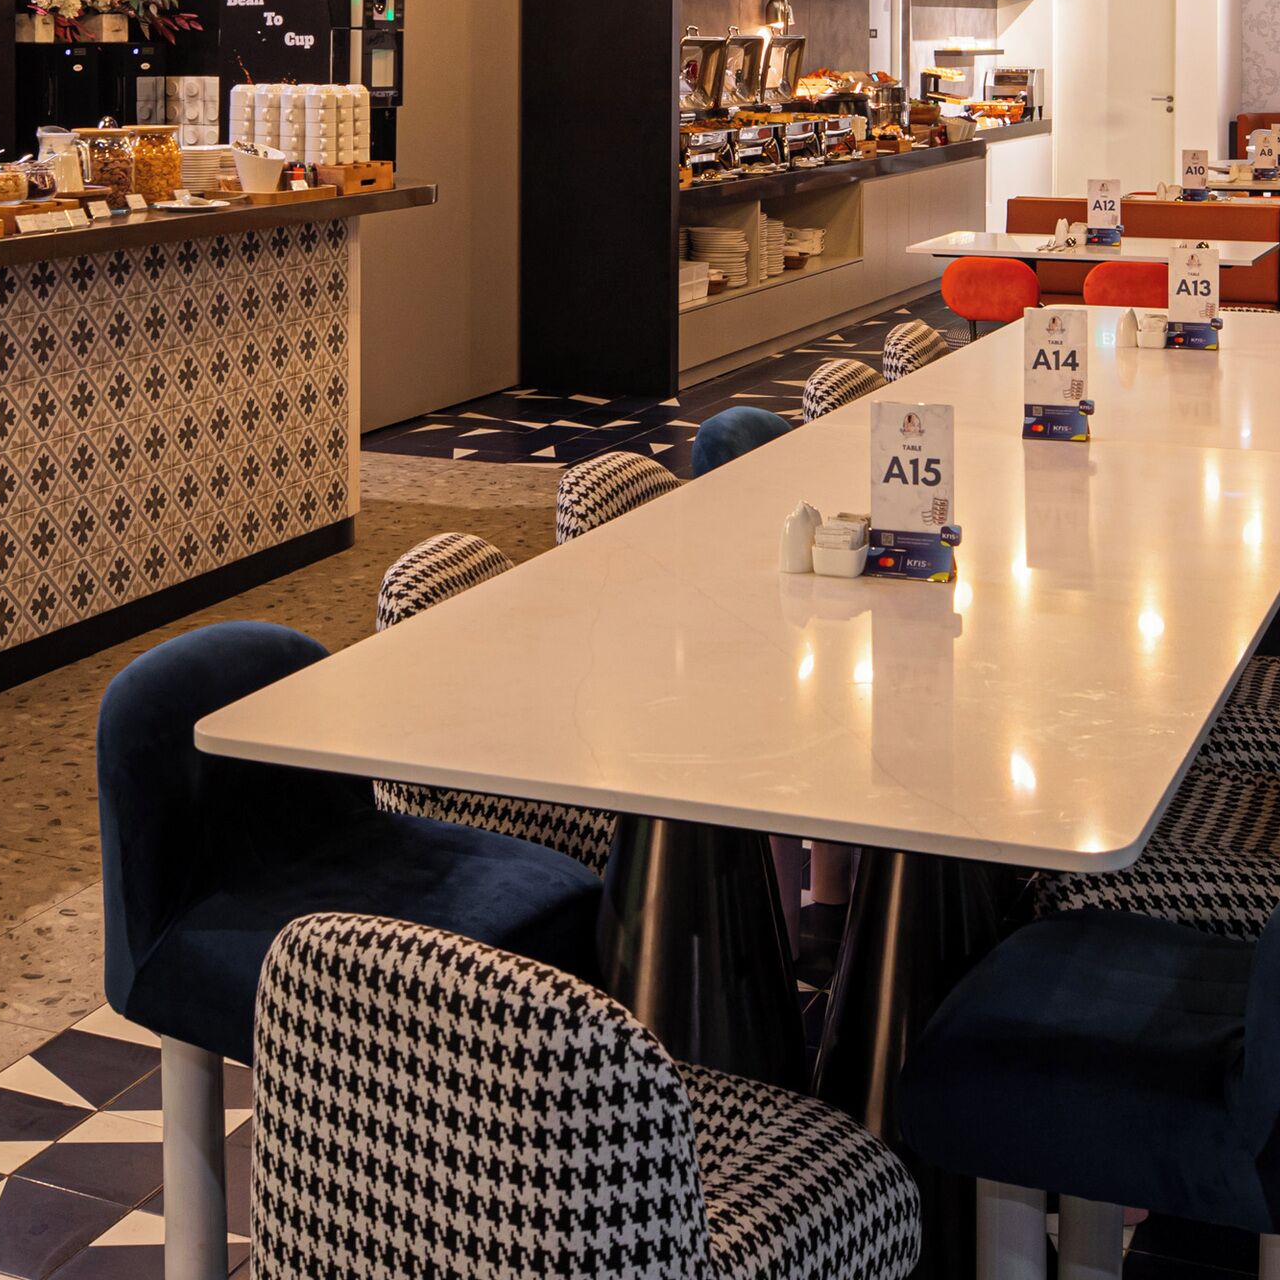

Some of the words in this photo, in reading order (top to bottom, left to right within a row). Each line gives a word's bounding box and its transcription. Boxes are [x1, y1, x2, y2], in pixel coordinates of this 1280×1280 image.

[263, 12, 283, 26] To
[284, 32, 314, 49] Cup
[1259, 148, 1273, 157] A8
[1185, 165, 1205, 176] A10
[1092, 200, 1116, 211] A12
[1176, 279, 1211, 296] A13
[1032, 348, 1079, 371] A14
[902, 444, 922, 452] TABLE
[882, 455, 941, 486] A15
